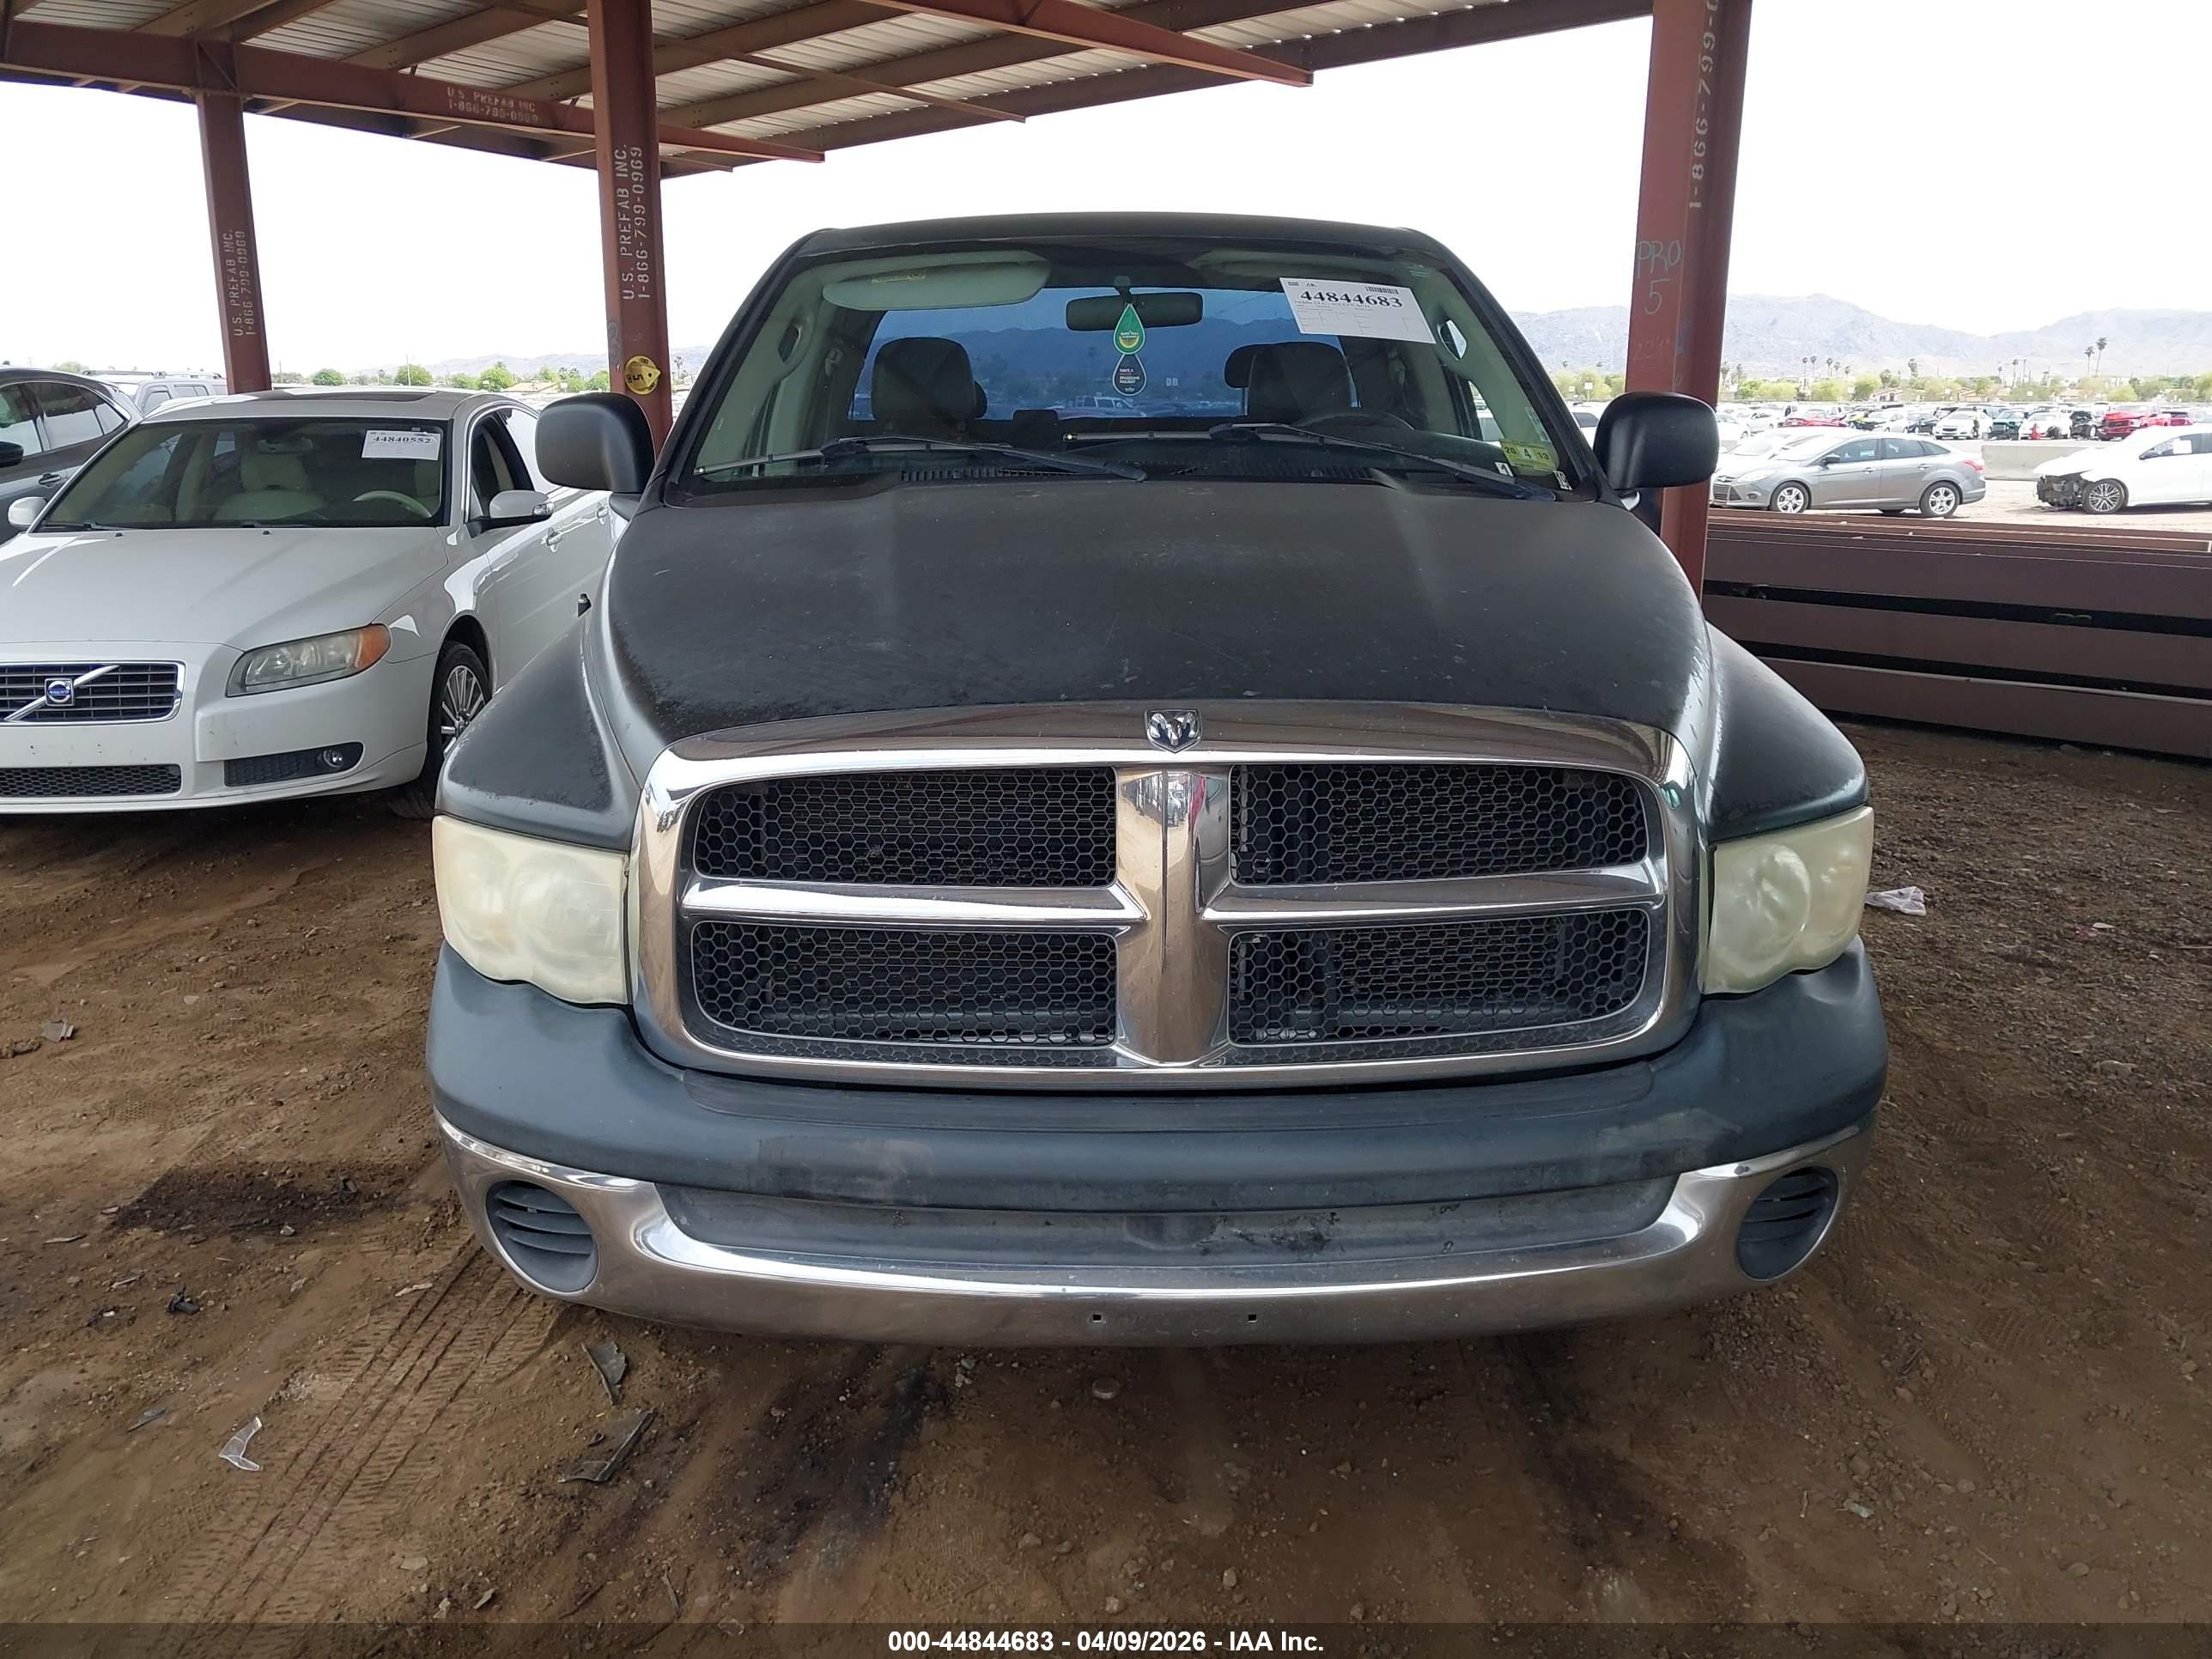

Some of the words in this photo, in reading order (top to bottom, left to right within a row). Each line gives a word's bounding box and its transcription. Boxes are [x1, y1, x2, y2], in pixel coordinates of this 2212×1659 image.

[614, 143, 628, 177] INC.
[617, 187, 633, 256] PREFAB
[629, 146, 650, 299] 1-866-799-0969
[1635, 240, 1682, 279] PRO
[226, 258, 240, 307] PREFAB
[234, 230, 257, 335] 1-866-799-0969
[622, 267, 635, 300] U.S.
[1301, 290, 1402, 308] 44844683
[1644, 277, 1670, 315] 5
[1523, 448, 1532, 459] 4
